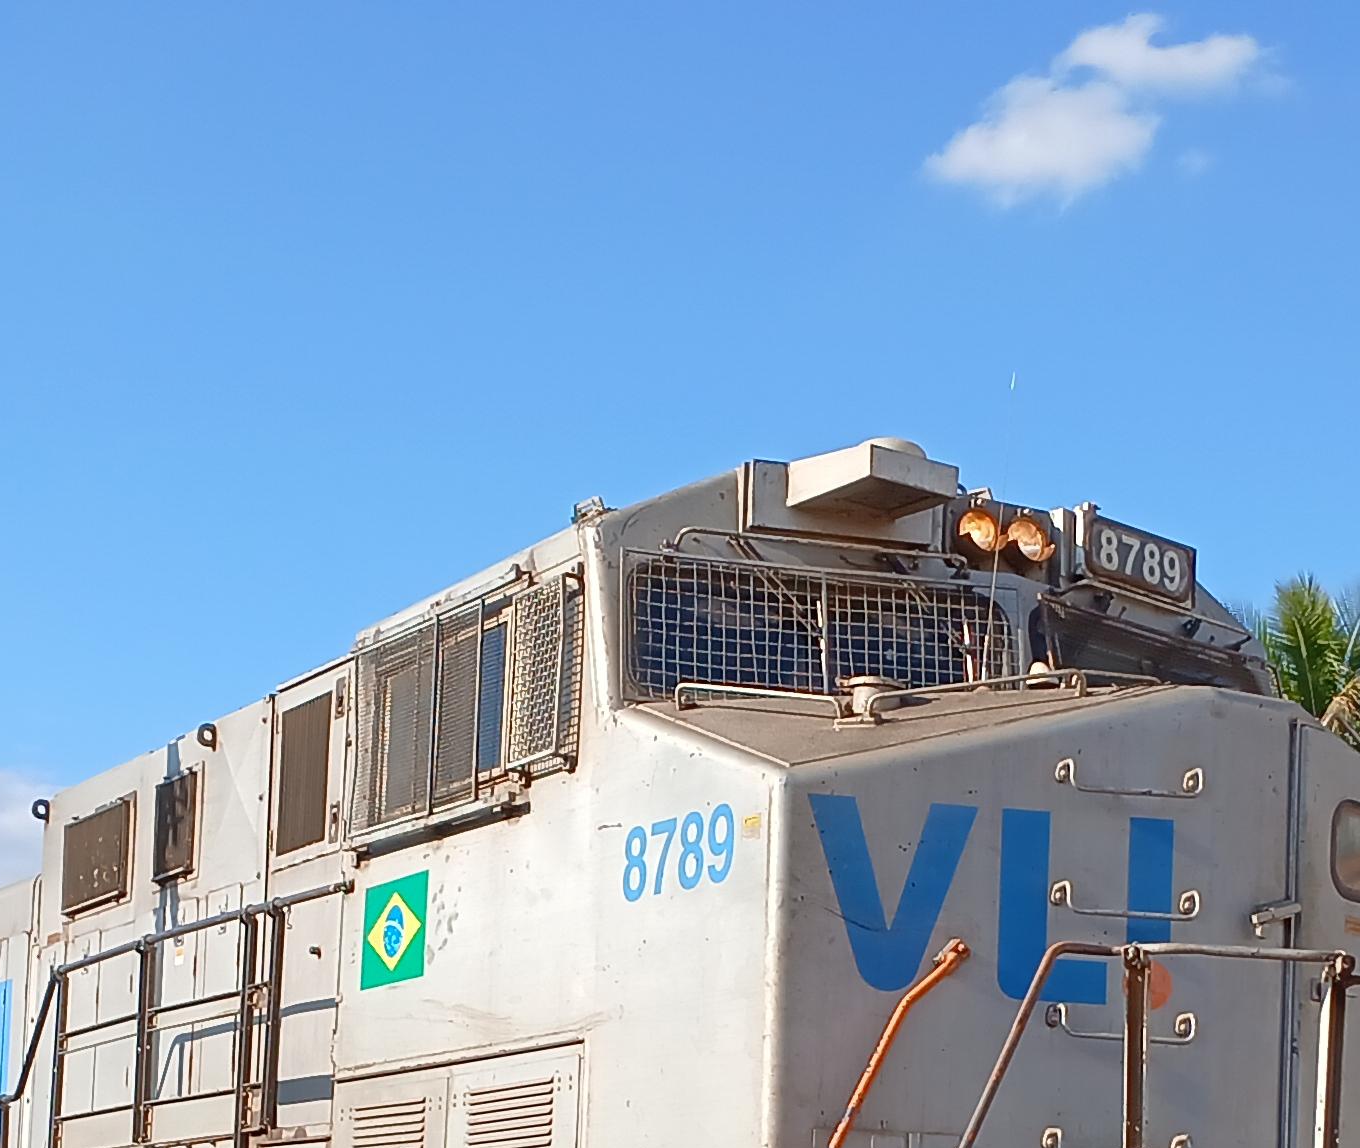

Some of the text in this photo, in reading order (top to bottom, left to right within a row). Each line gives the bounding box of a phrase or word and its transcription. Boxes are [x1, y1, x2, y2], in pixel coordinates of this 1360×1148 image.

[1100, 529, 1181, 592] 8789
[623, 803, 735, 902] 8789
[807, 793, 1174, 1006] VLI
